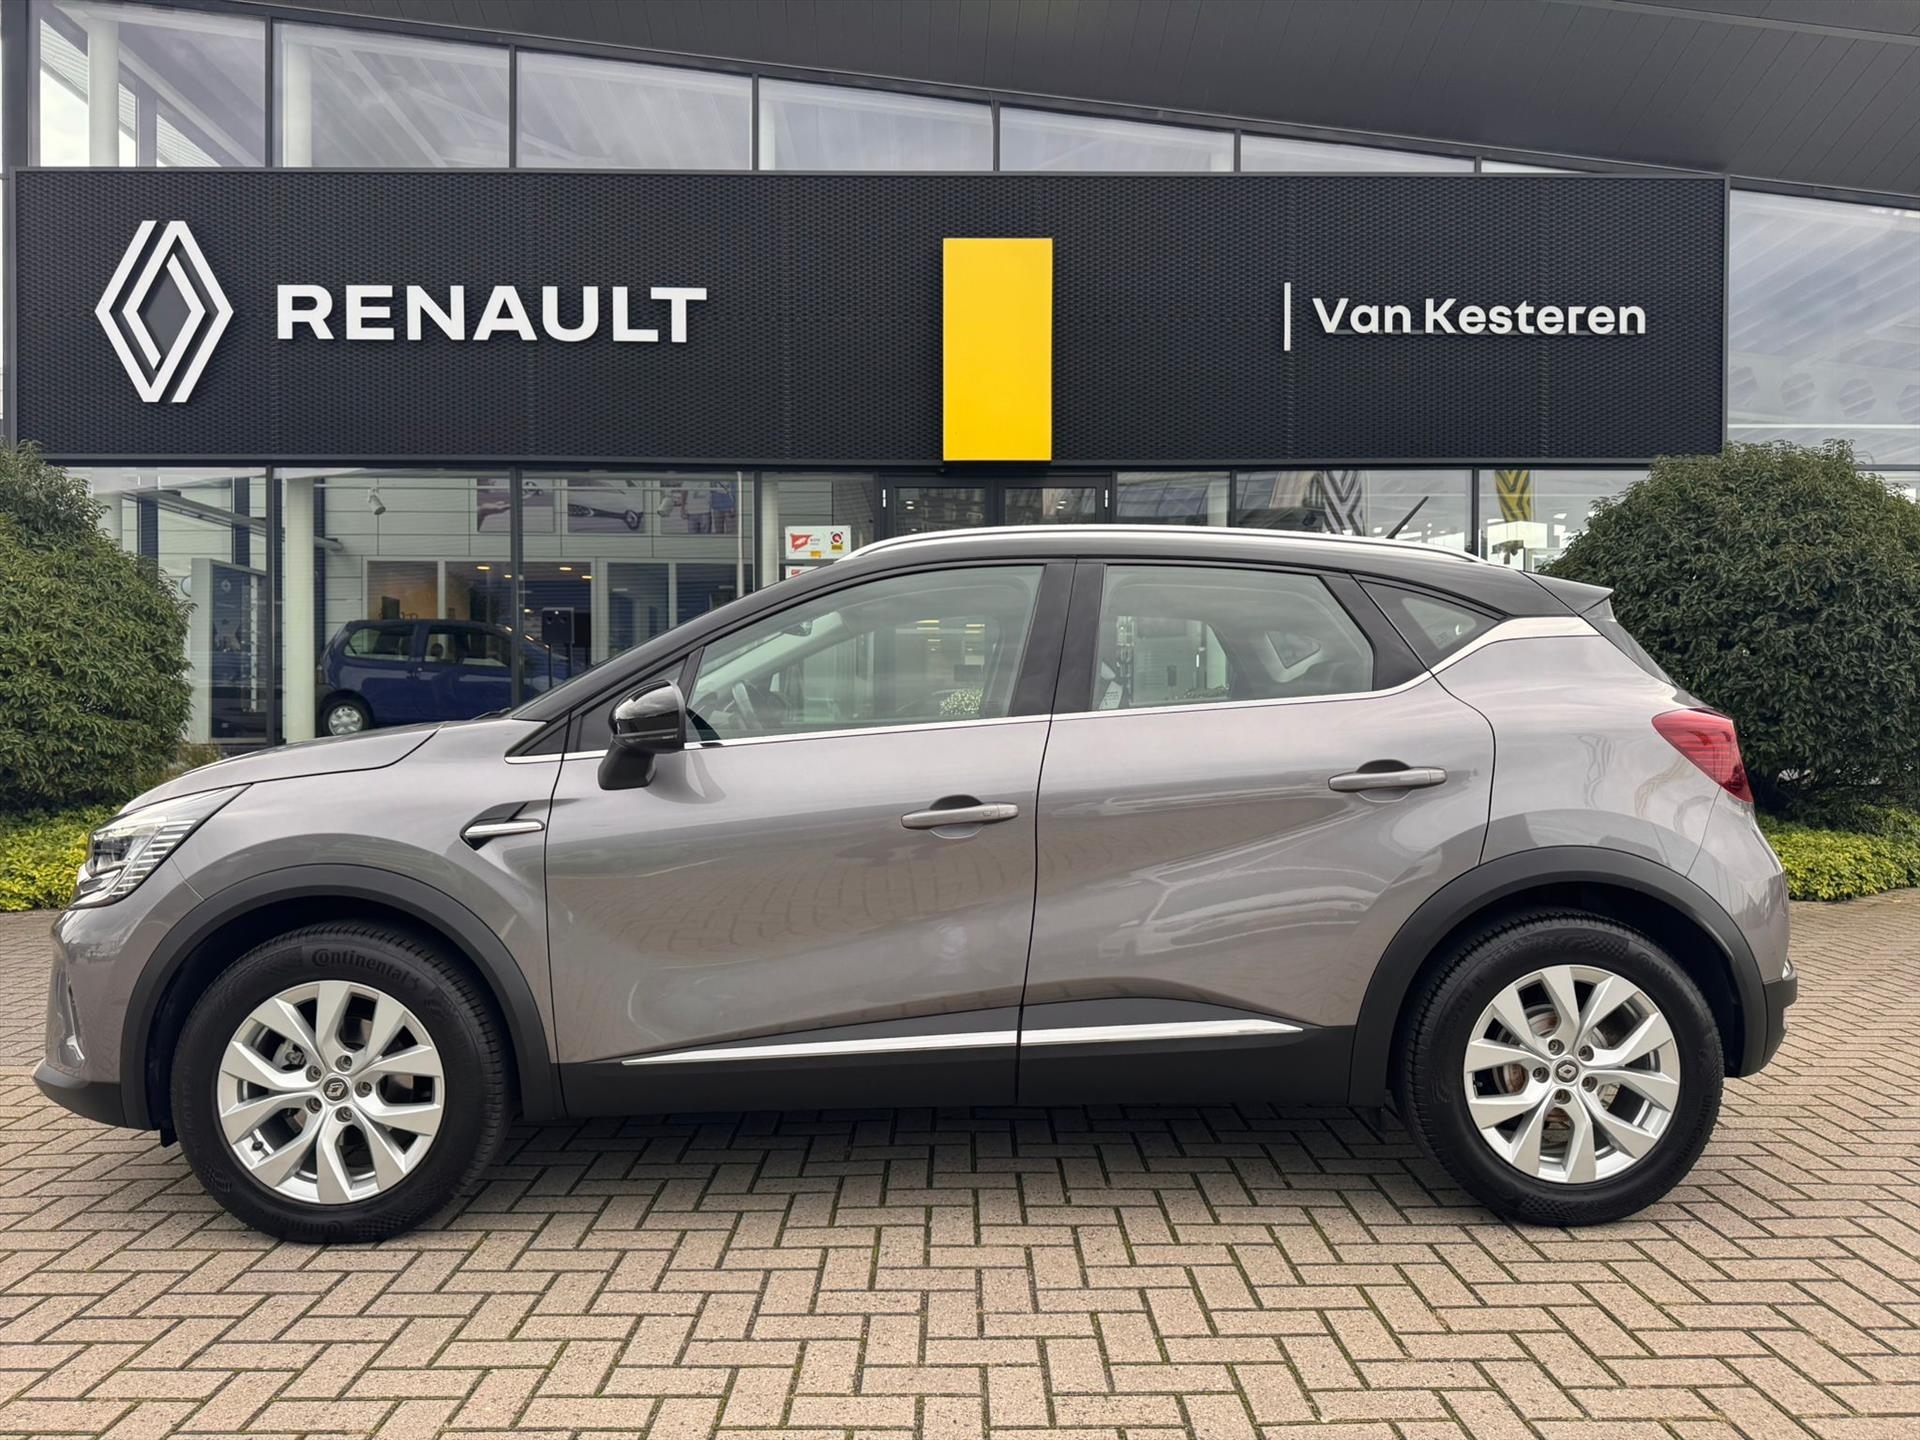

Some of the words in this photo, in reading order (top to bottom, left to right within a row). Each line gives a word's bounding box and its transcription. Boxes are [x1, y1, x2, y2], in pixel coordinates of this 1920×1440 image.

[277, 284, 708, 344] RENAULT
[1312, 298, 1412, 334] Van
[1425, 298, 1646, 335] Kesteren
[311, 948, 410, 982] Continental
